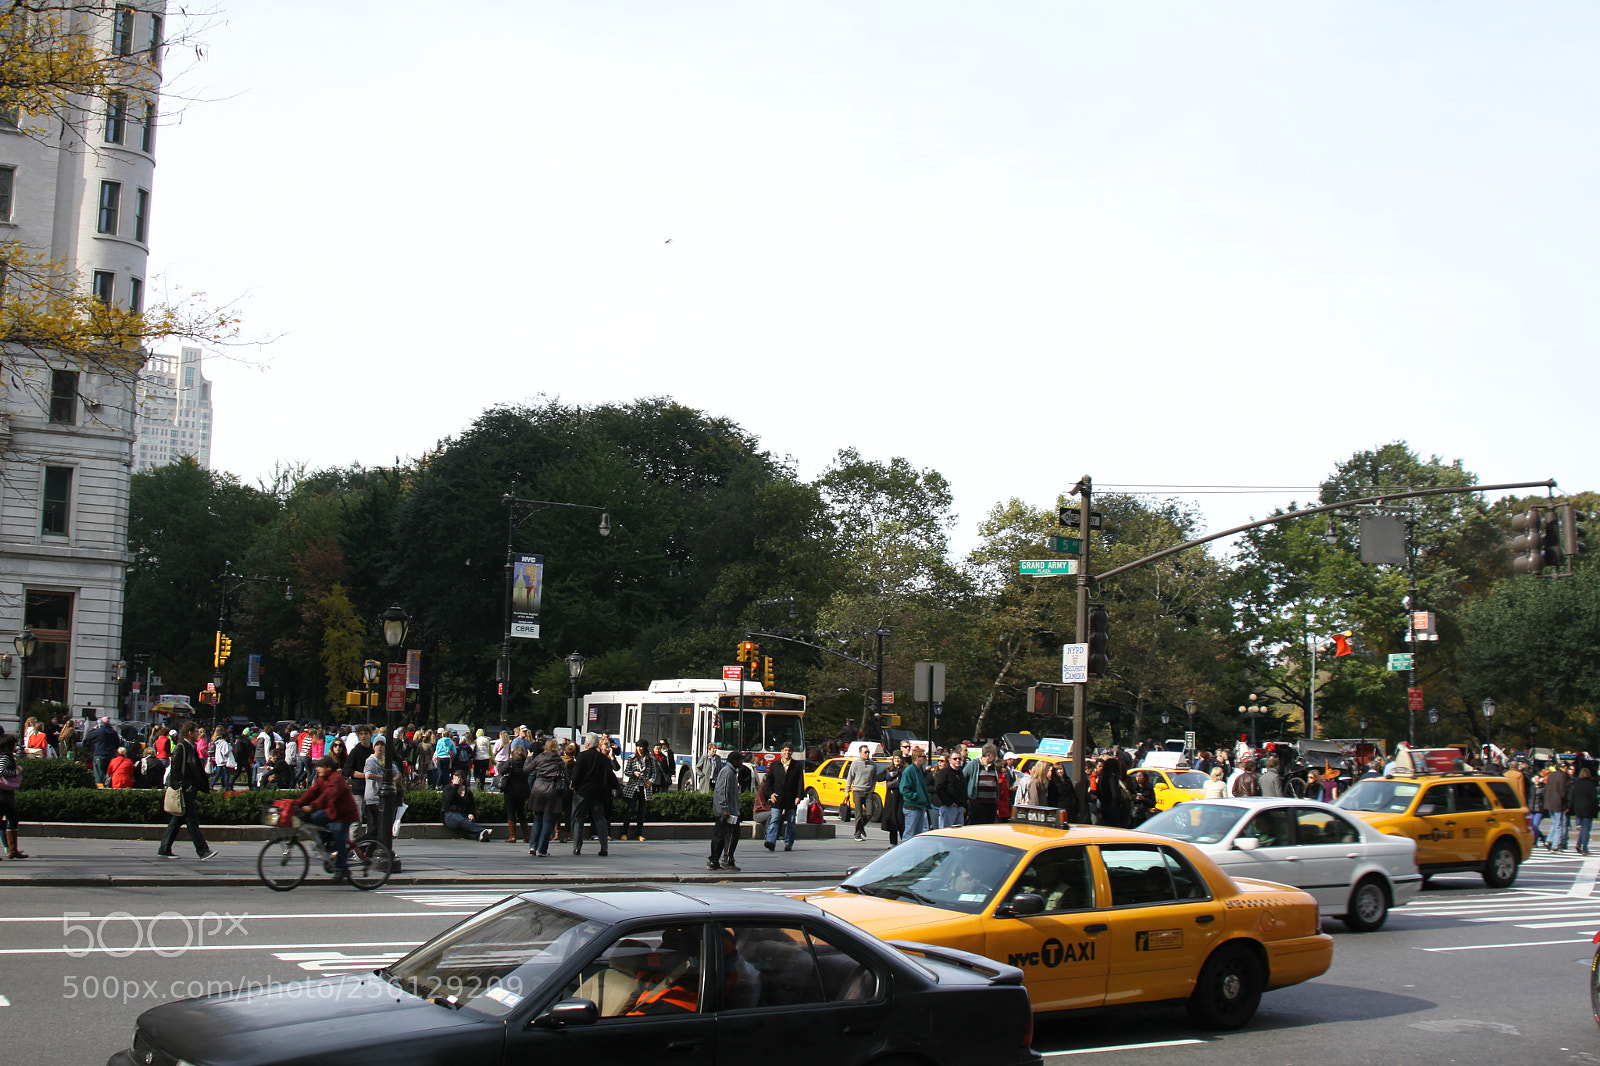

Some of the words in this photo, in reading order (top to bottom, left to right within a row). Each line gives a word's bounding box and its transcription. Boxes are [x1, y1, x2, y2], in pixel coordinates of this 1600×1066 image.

[1064, 513, 1077, 522] ONE
[1063, 539, 1070, 551] 5
[1022, 561, 1045, 570] GRAND
[1047, 561, 1067, 570] ARMY
[1067, 646, 1084, 655] NYPD
[1063, 664, 1087, 672] SECURITY
[1064, 672, 1086, 680] CAMERA
[765, 699, 776, 708] ST
[1008, 952, 1040, 967] NYC
[1043, 940, 1096, 967] TAXI
